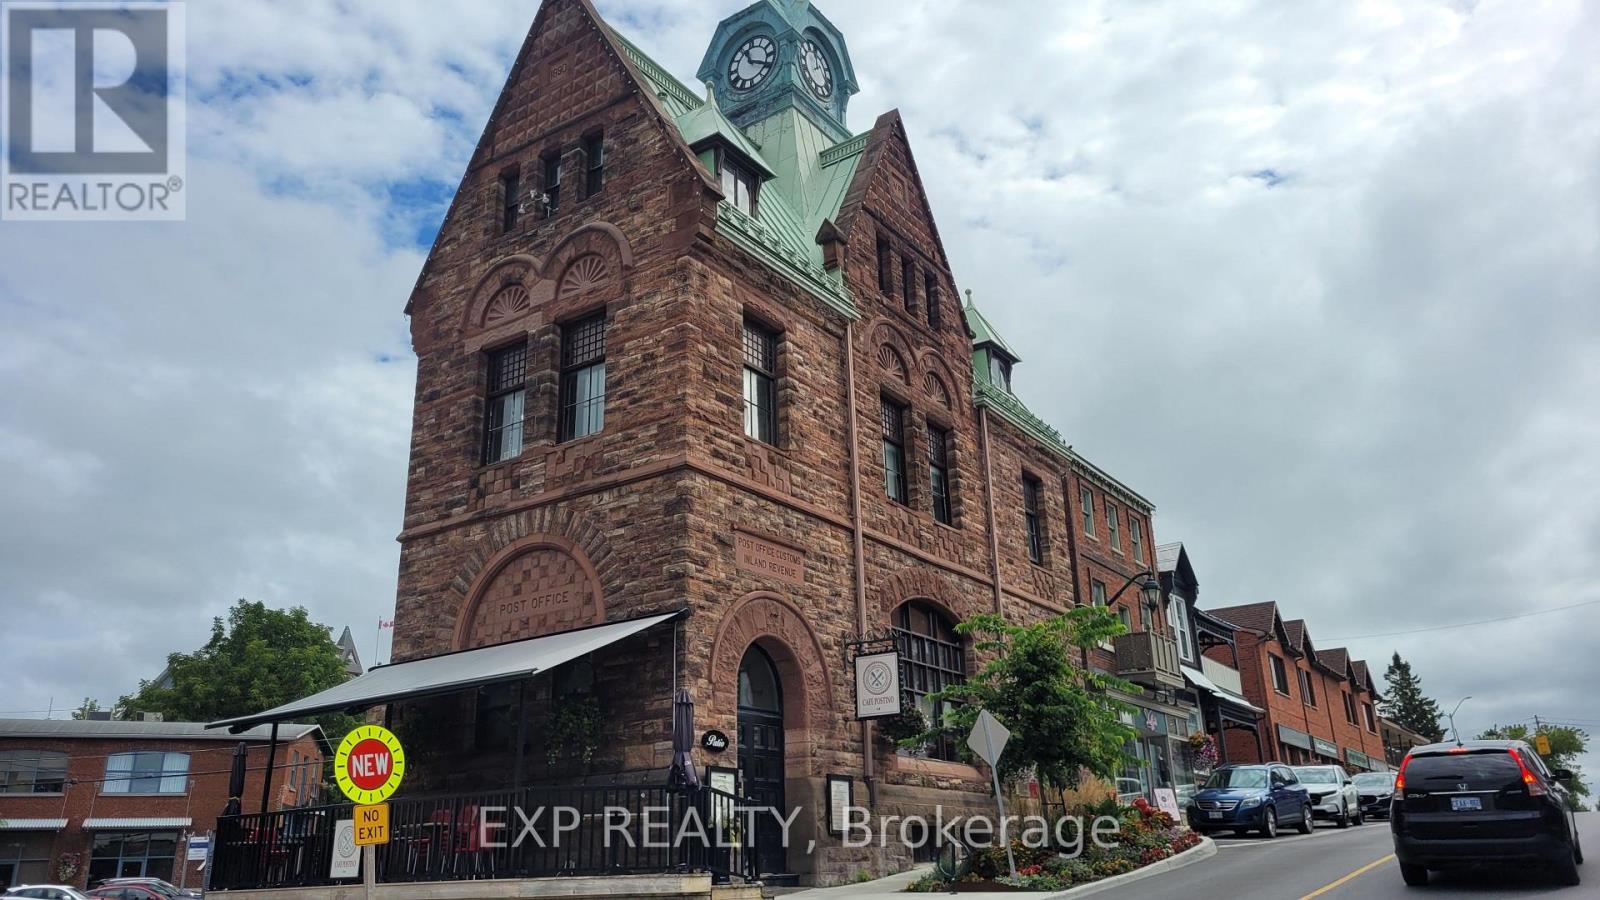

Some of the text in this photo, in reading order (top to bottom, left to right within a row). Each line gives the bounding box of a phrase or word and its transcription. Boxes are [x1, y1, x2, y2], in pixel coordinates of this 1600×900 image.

[738, 537, 754, 551] POST
[756, 543, 775, 557] OFFICE
[743, 553, 796, 578] INLAND REVENUE
[500, 590, 569, 616] POST OFFICE
[706, 734, 725, 748] Patio
[352, 752, 389, 778] NEW
[363, 809, 380, 823] NO
[358, 825, 385, 840] EXIT
